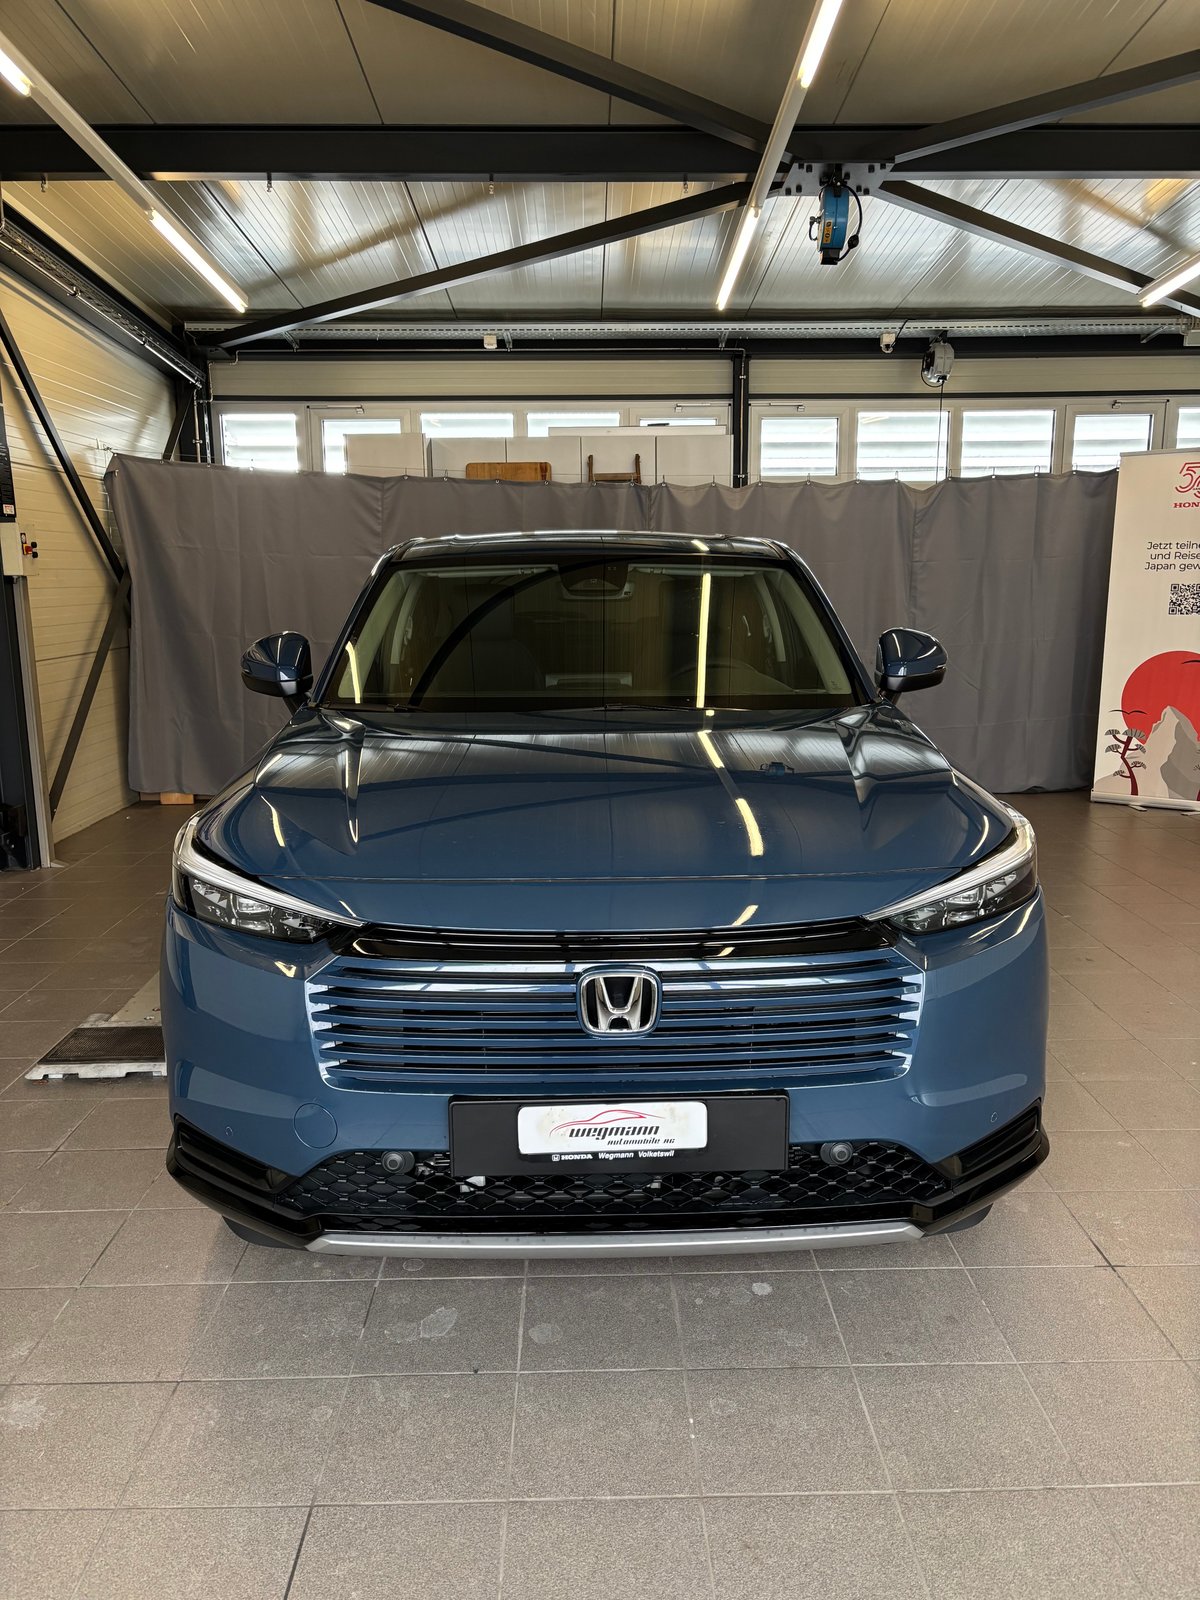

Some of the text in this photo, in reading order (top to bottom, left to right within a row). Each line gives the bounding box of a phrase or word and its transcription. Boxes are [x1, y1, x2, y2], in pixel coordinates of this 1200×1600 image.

[1147, 541, 1172, 550] Jetzt
[1150, 551, 1171, 560] und
[1144, 561, 1176, 572] Japan
[569, 1125, 660, 1141] wegmann
[607, 1137, 661, 1146] automobile
[560, 1149, 675, 1161] HONDA Wegmann Volketswil
